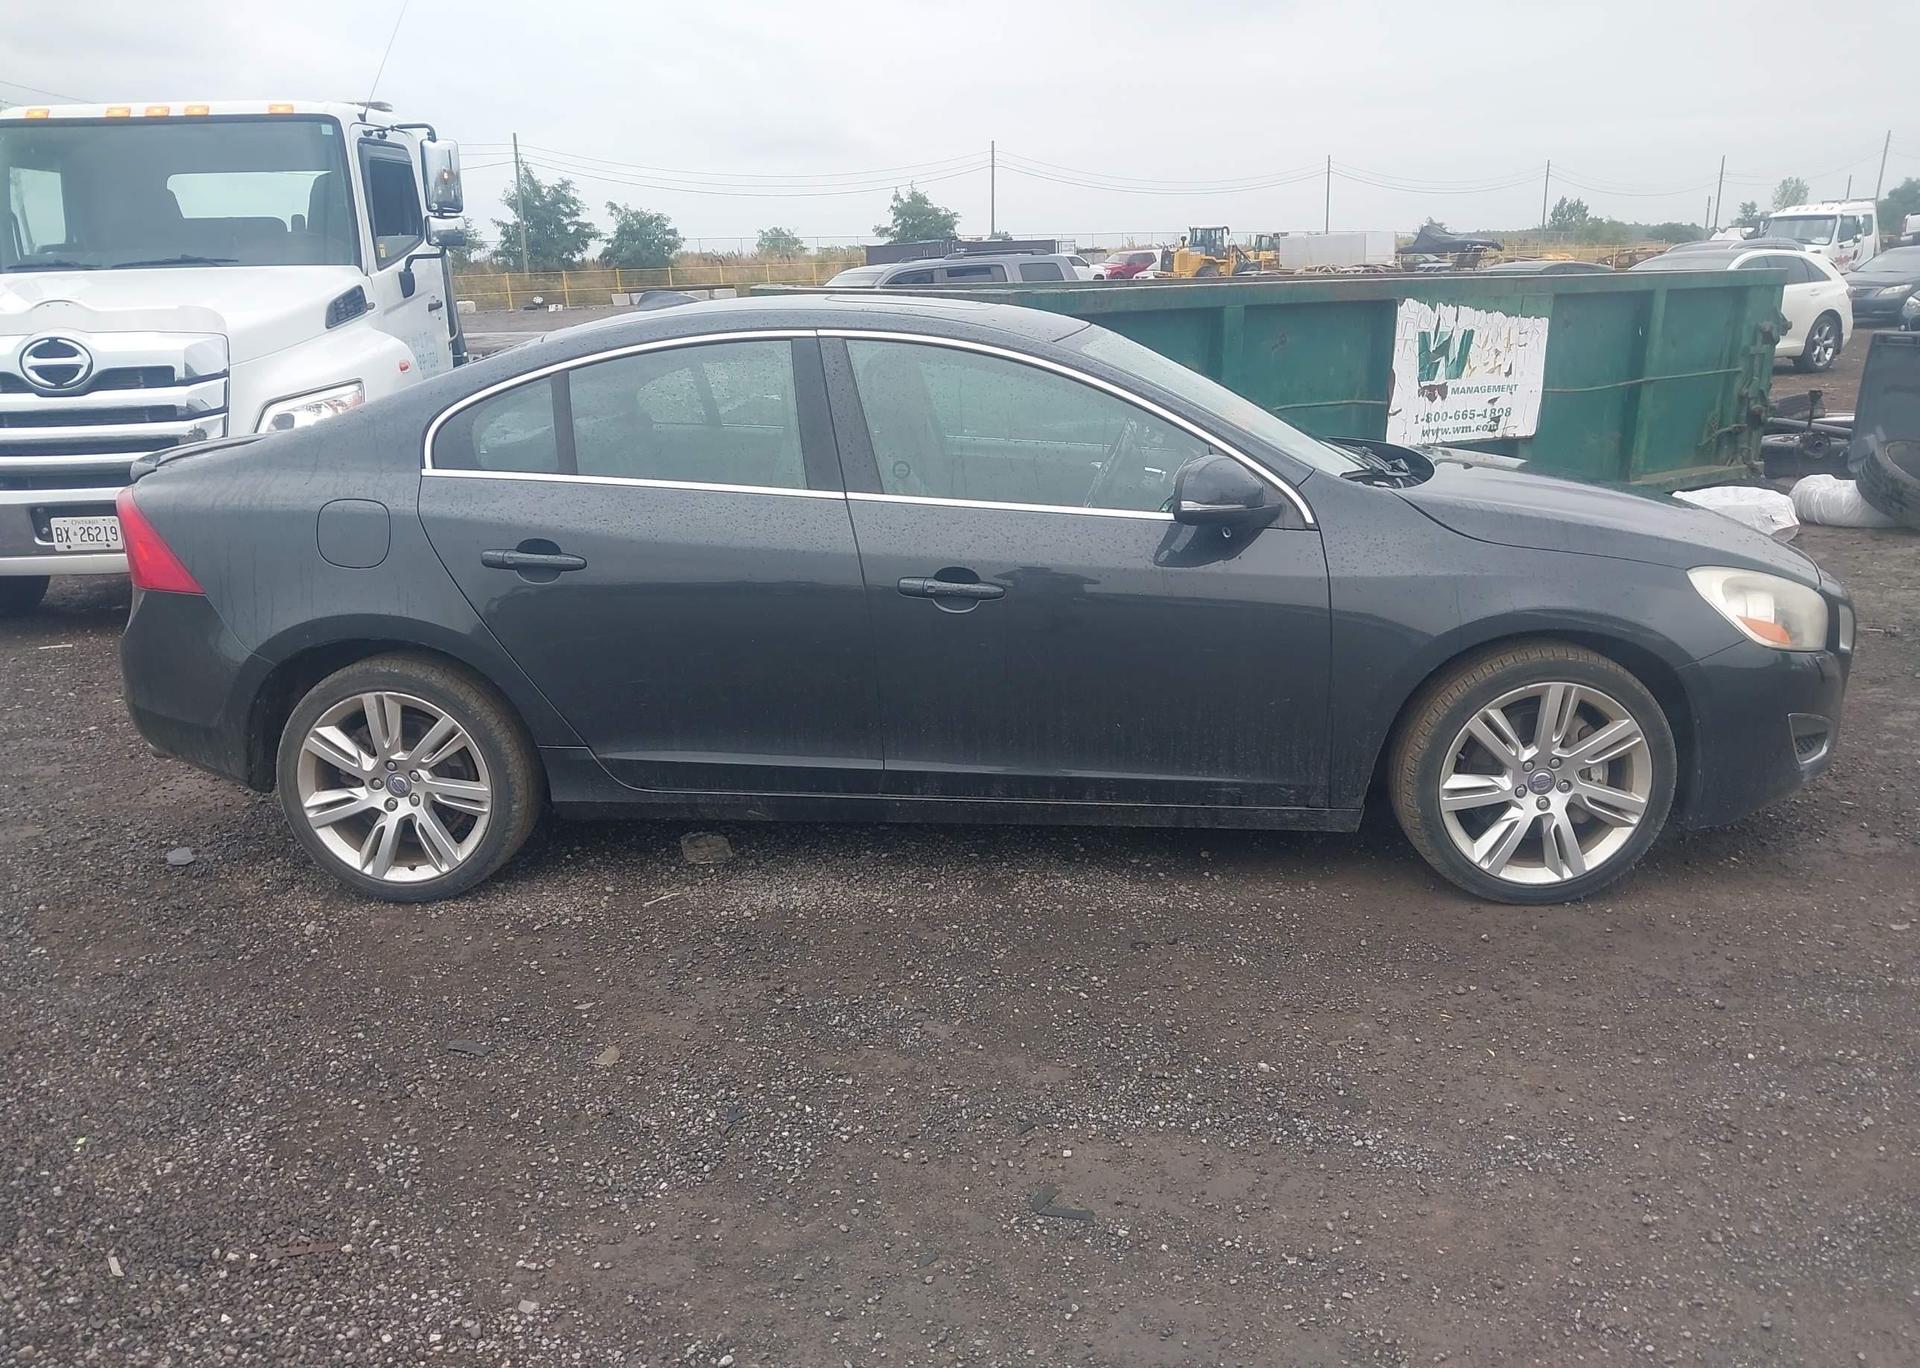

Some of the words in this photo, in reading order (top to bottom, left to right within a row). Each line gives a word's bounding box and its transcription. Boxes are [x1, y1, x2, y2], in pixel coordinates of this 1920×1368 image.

[1451, 384, 1519, 395] MANAGEMENT
[55, 527, 72, 543] BX
[78, 526, 118, 542] 26219
